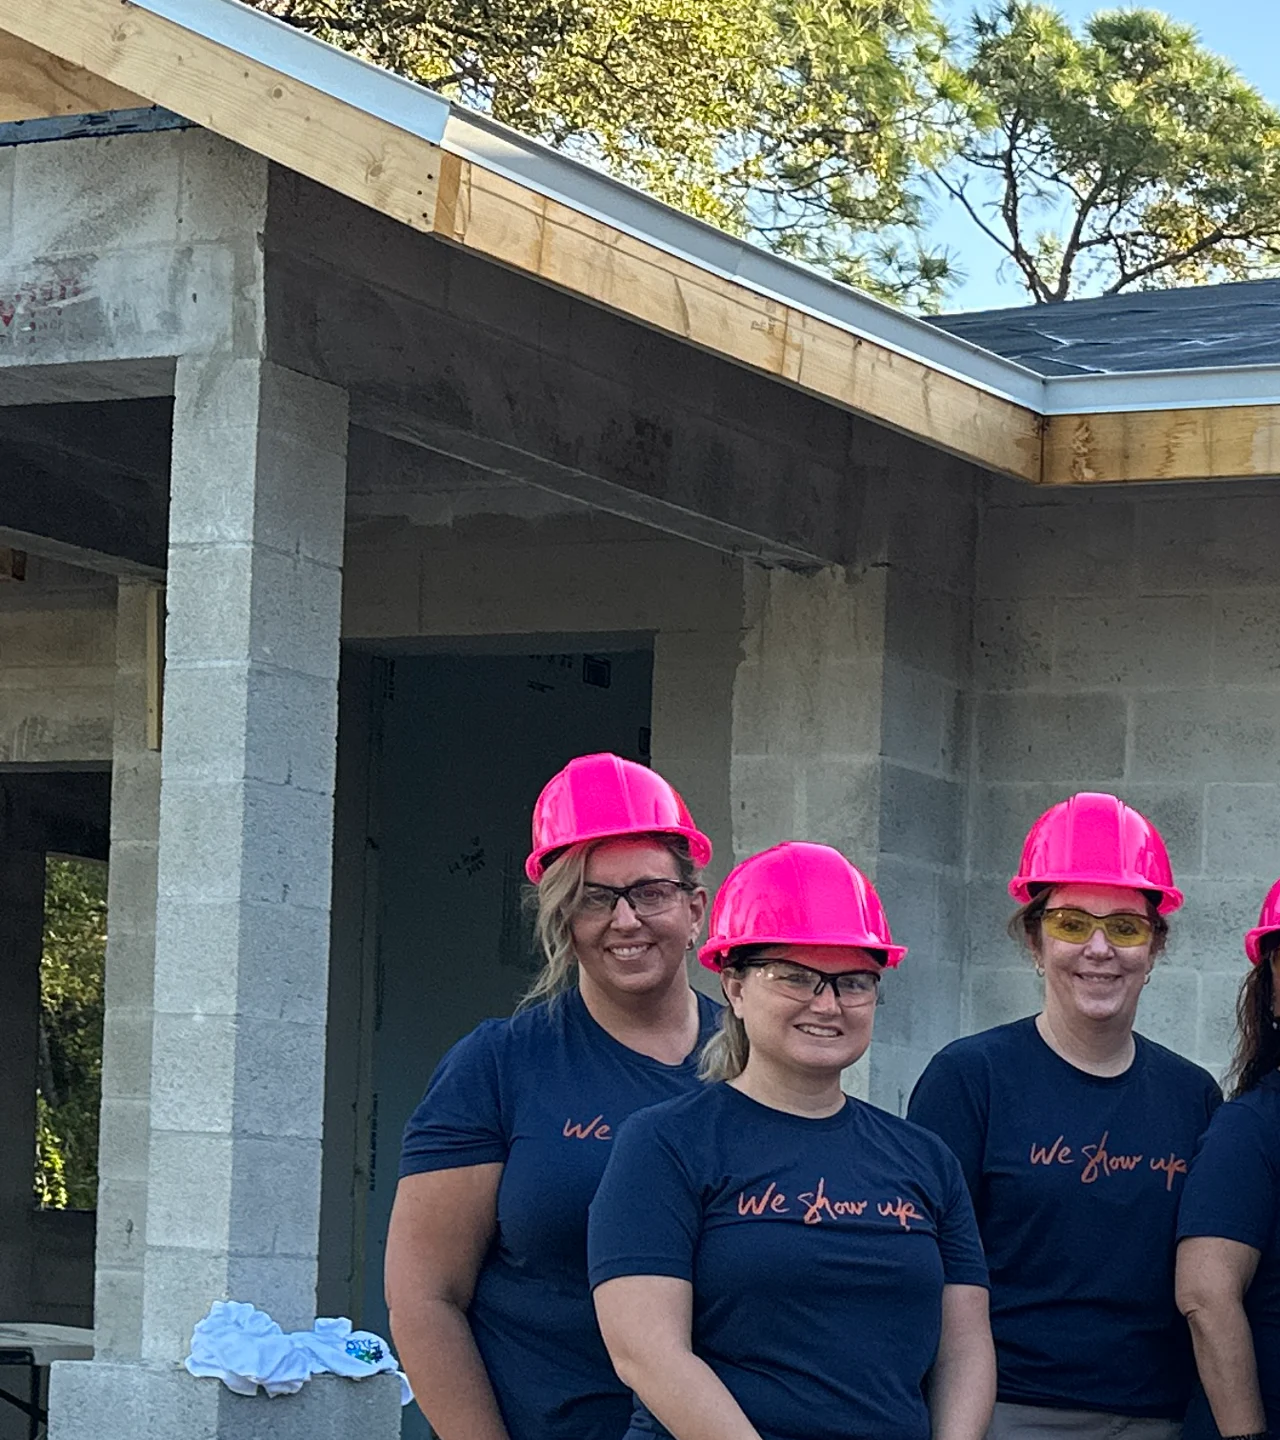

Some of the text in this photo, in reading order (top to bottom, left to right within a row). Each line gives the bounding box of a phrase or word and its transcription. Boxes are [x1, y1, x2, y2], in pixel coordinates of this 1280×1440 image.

[563, 1115, 612, 1141] We
[1029, 1131, 1188, 1191] We show up
[737, 1177, 925, 1233] We show up
